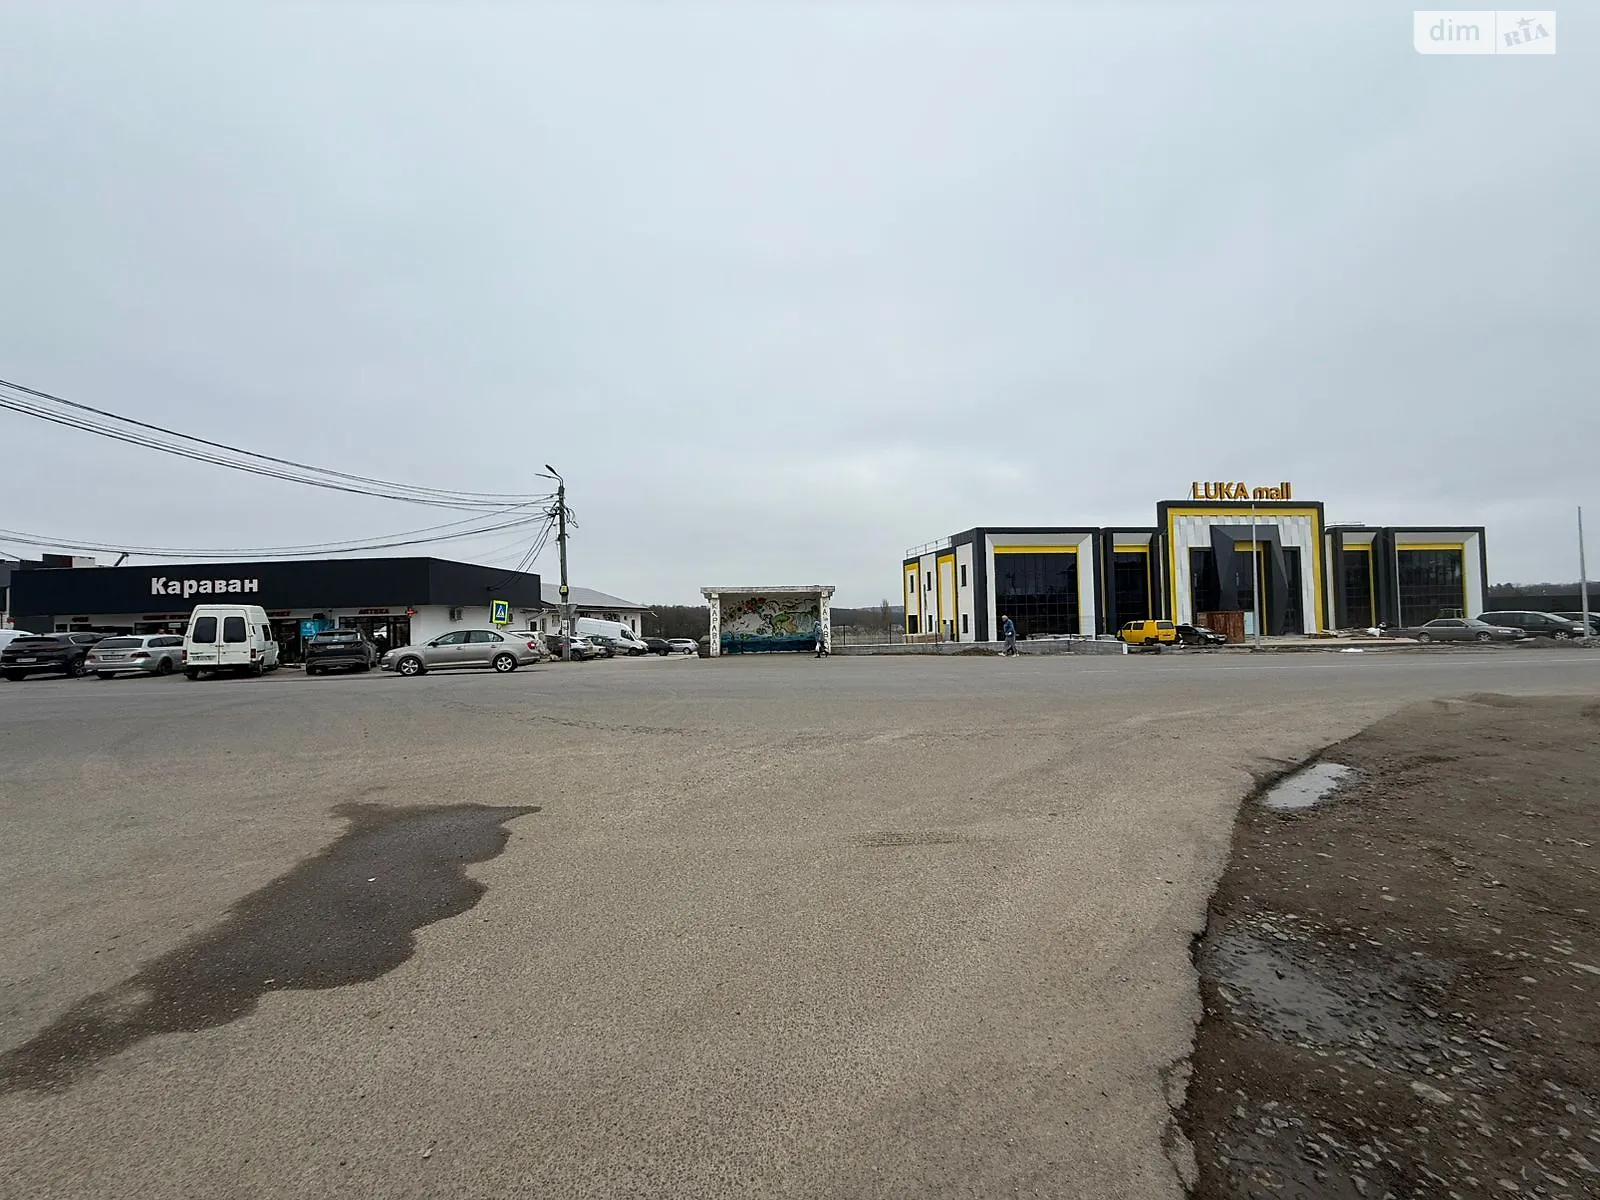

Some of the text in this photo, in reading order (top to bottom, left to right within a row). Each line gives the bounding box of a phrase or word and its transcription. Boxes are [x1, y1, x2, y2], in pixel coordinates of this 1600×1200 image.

[1192, 481, 1292, 500] LUKA mall
[151, 577, 259, 599] Караван
